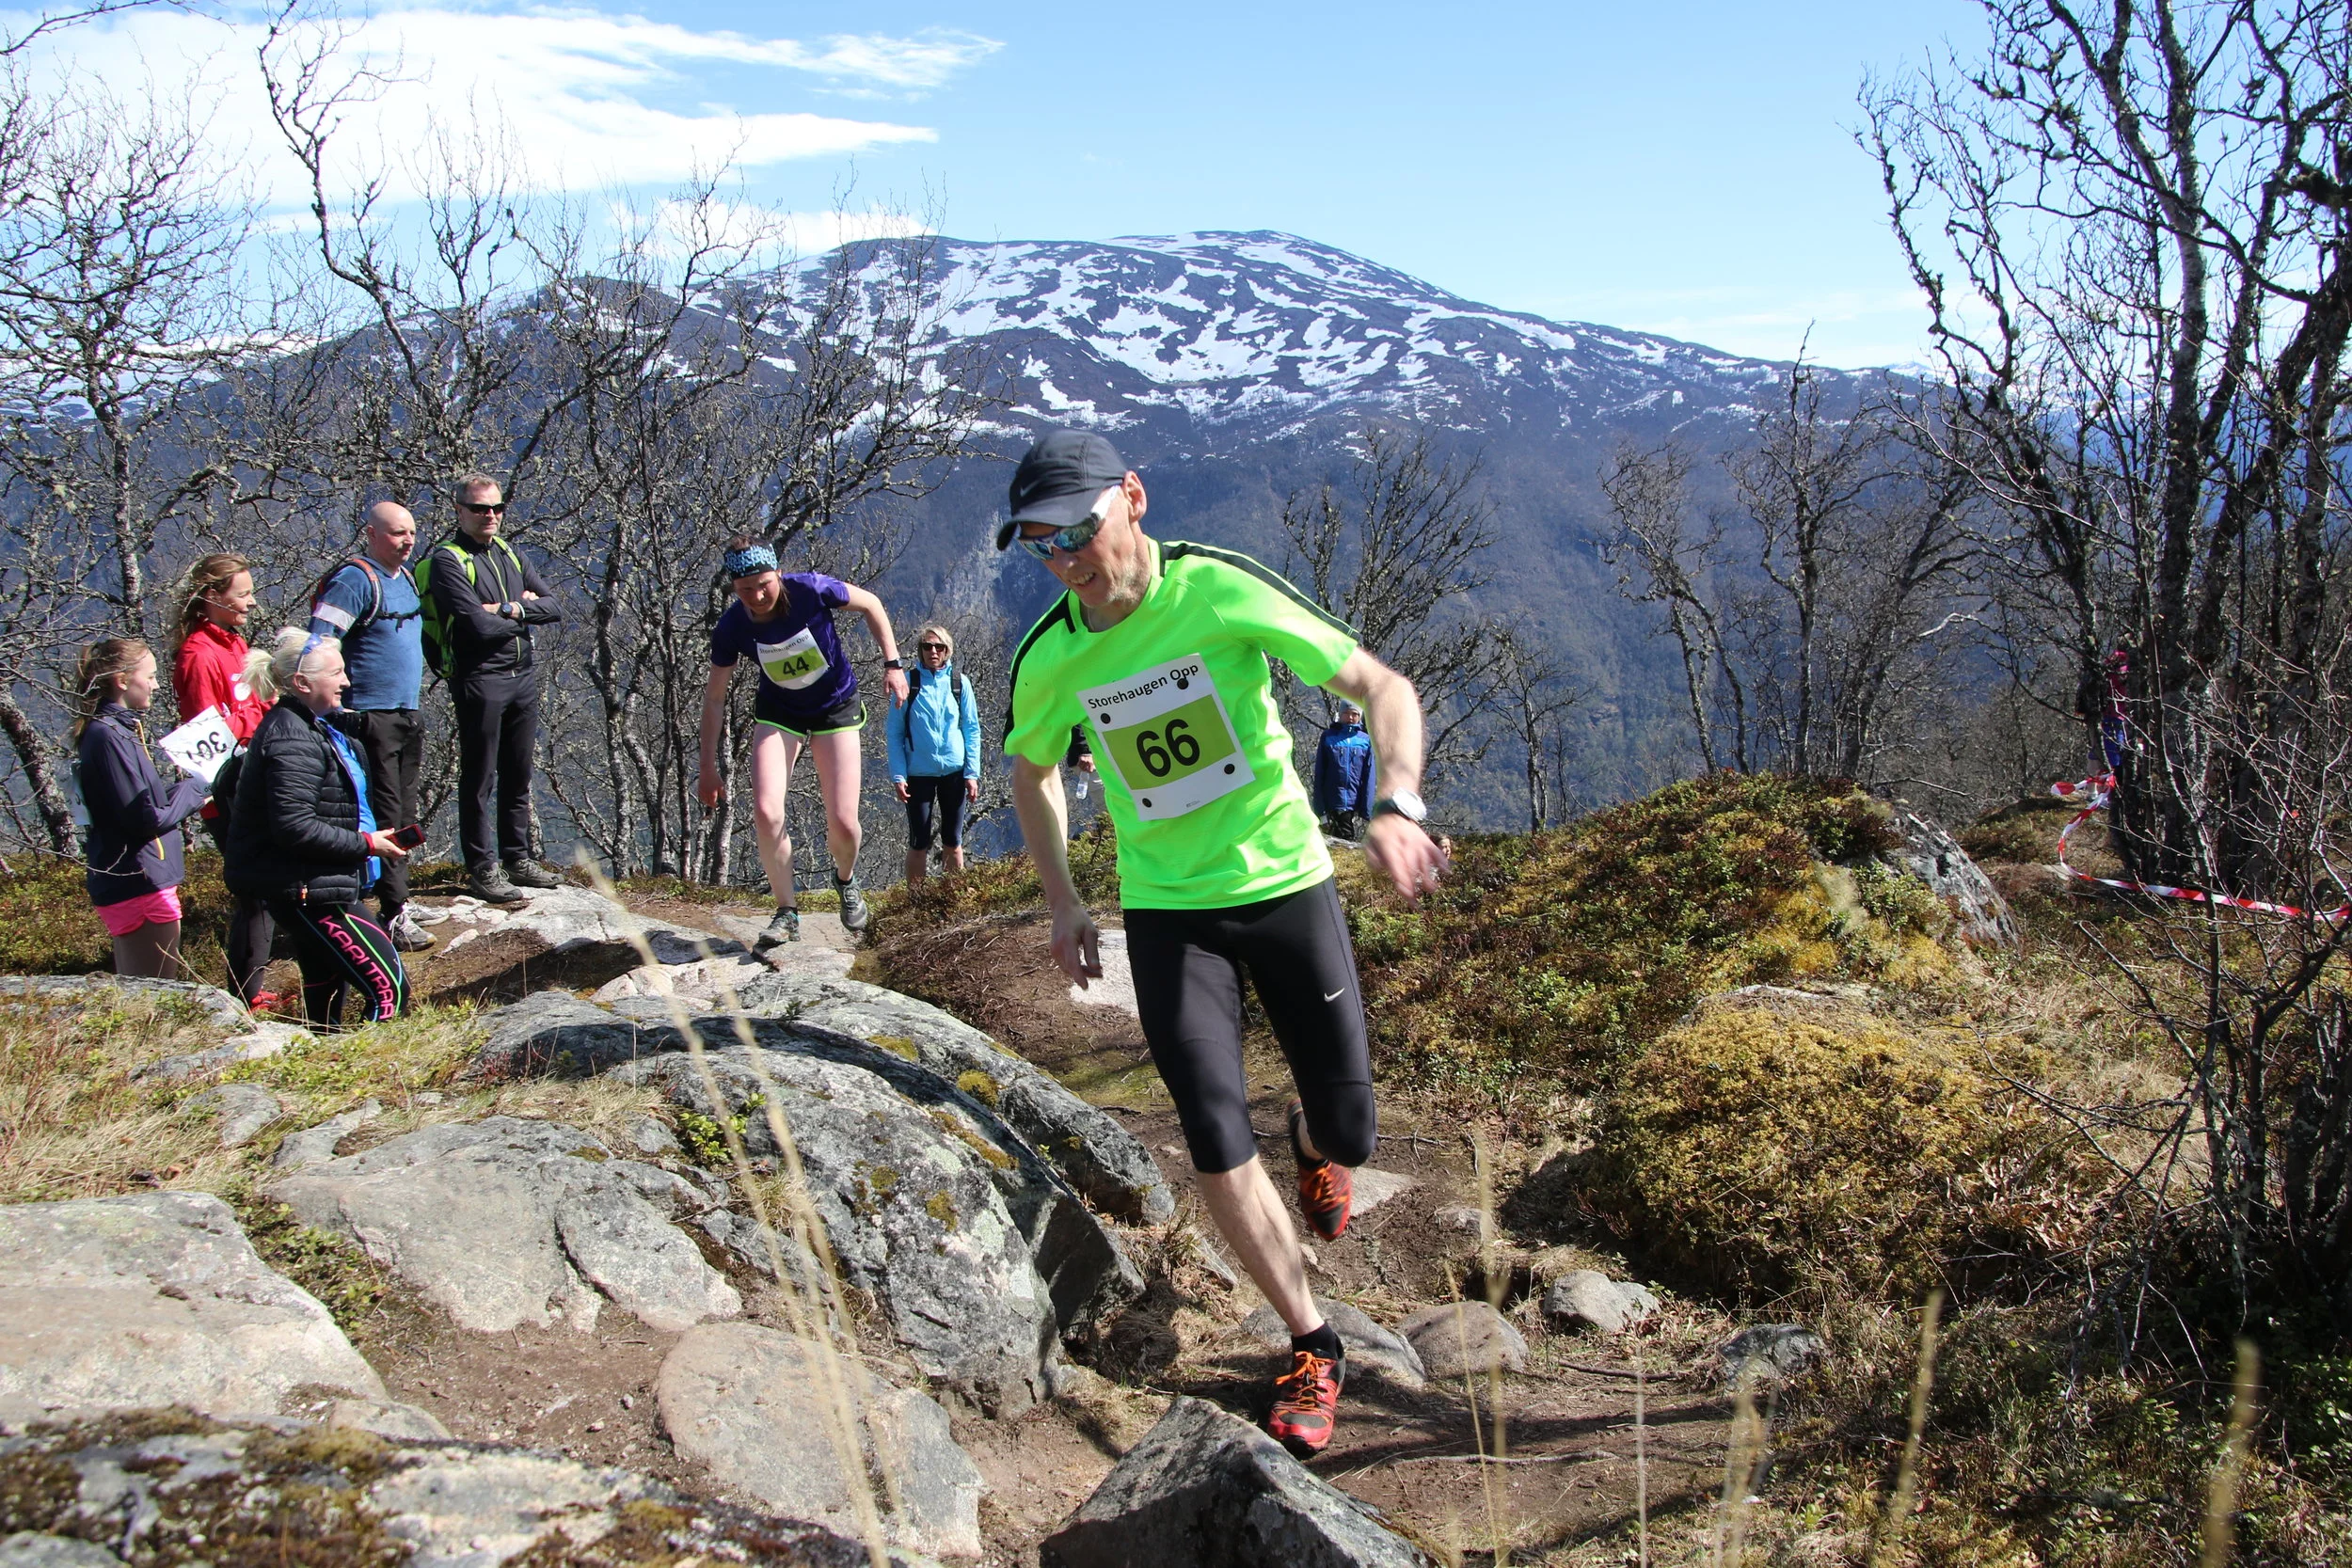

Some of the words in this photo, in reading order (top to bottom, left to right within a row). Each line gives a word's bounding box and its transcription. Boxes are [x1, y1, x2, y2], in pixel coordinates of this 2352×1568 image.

[783, 657, 809, 676] 44
[1088, 675, 1168, 708] Storehaugen
[1169, 664, 1199, 683] Opp
[186, 732, 227, 767] 301
[1136, 719, 1200, 778] 66
[318, 915, 370, 965] KARI
[365, 961, 394, 1020] TRAA
